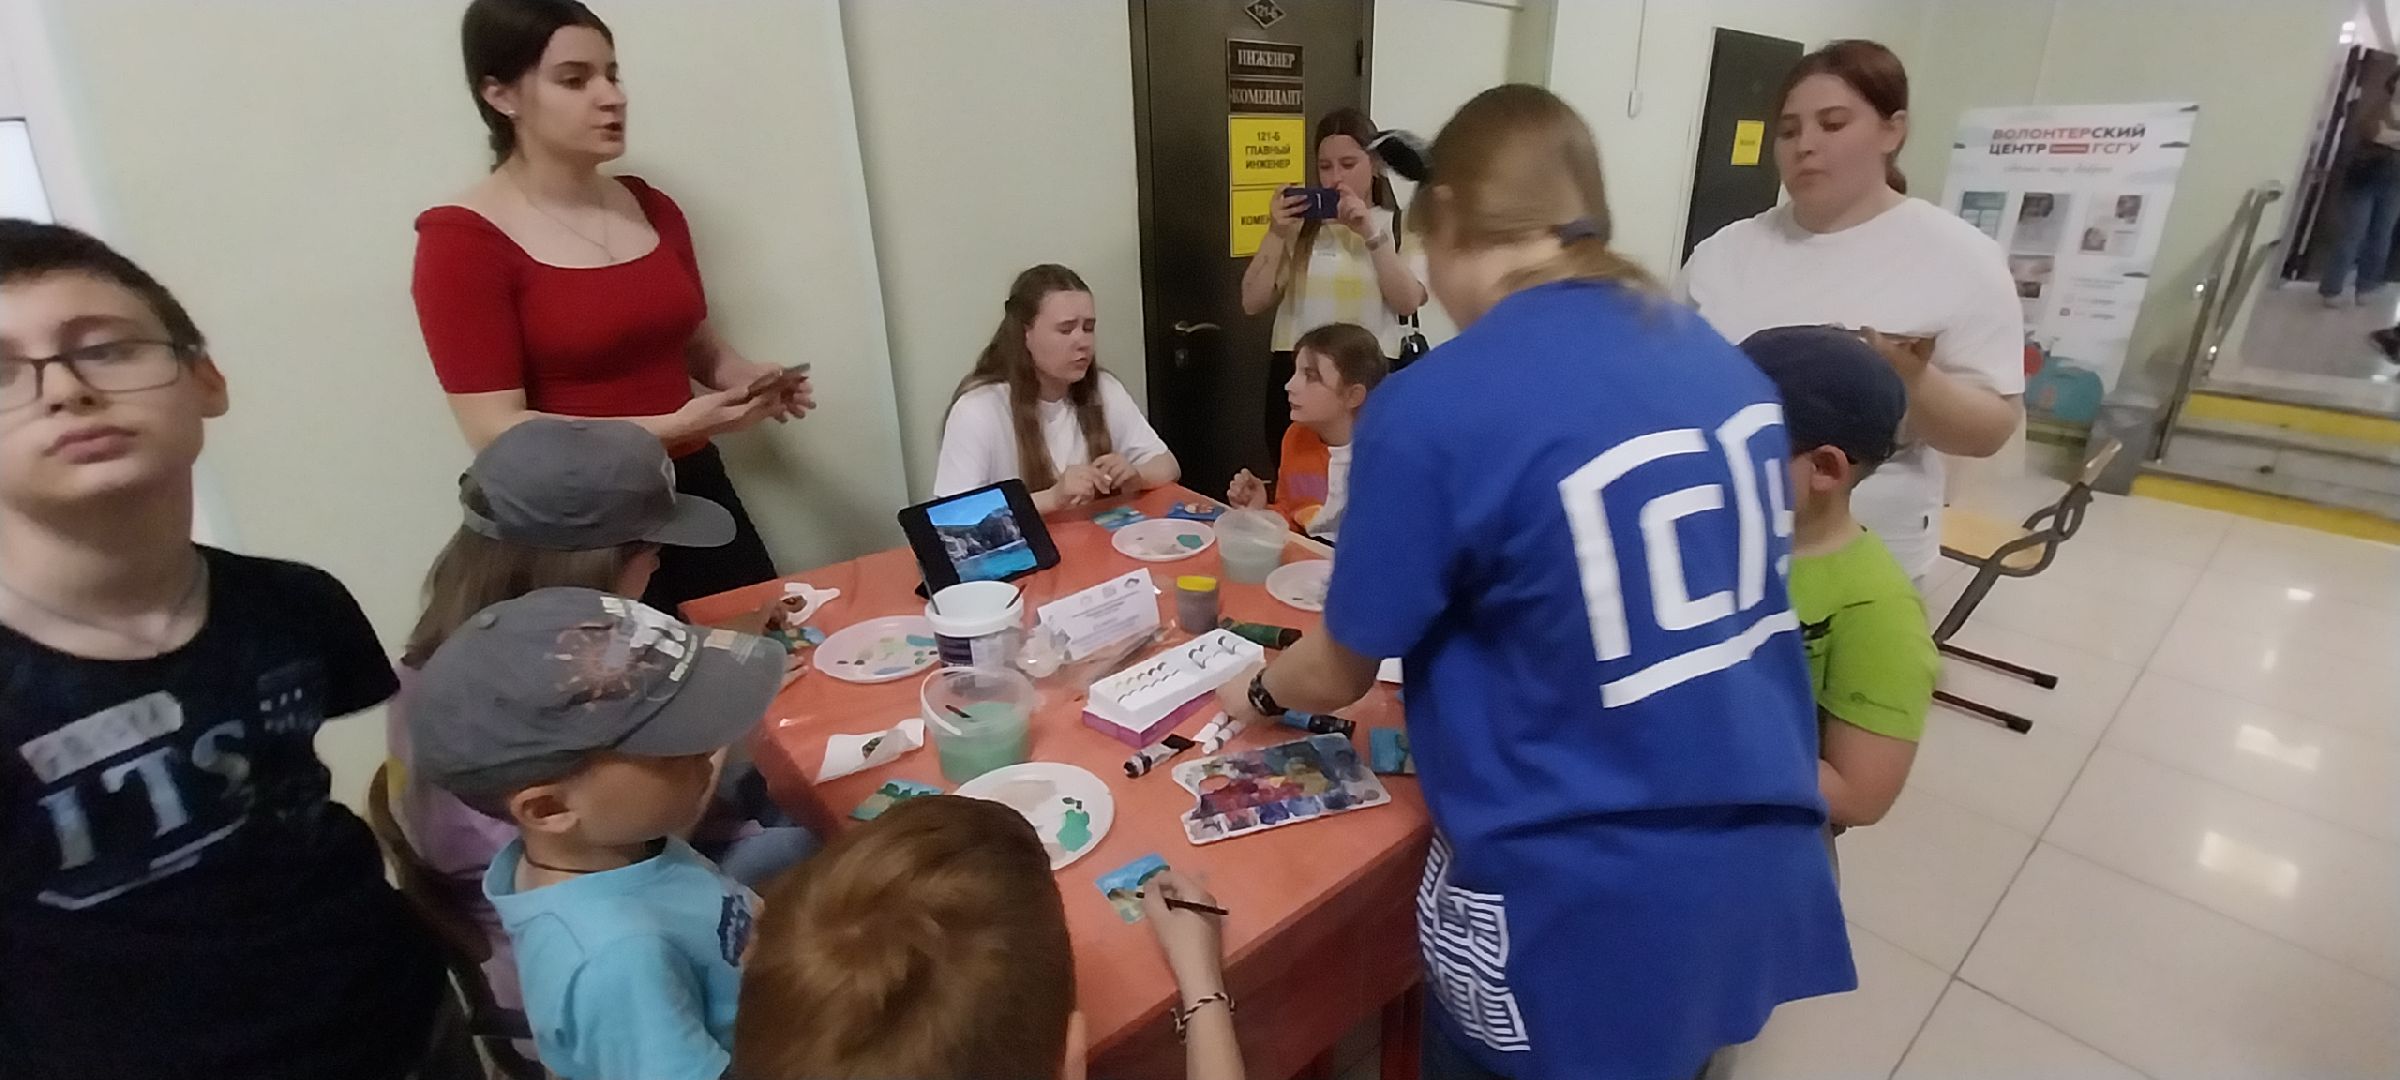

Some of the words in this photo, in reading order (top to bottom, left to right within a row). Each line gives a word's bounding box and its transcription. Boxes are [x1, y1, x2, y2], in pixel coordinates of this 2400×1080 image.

[1237, 48, 1296, 69] ИНЖЕНЕР
[1232, 88, 1302, 106] КОМЕНДАНТ
[1257, 131, 1281, 142] 121-Б
[1992, 123, 2146, 140] ВОЛОНТЕРСКИЙ
[1245, 144, 1291, 155] ГЛАВНЫЙ
[1989, 143, 2047, 155] ЦЕНТР
[2092, 142, 2141, 154] ГСГУ
[1246, 159, 1291, 169] ИНЖЕНЕР
[1241, 214, 1271, 226] КОМЕН
